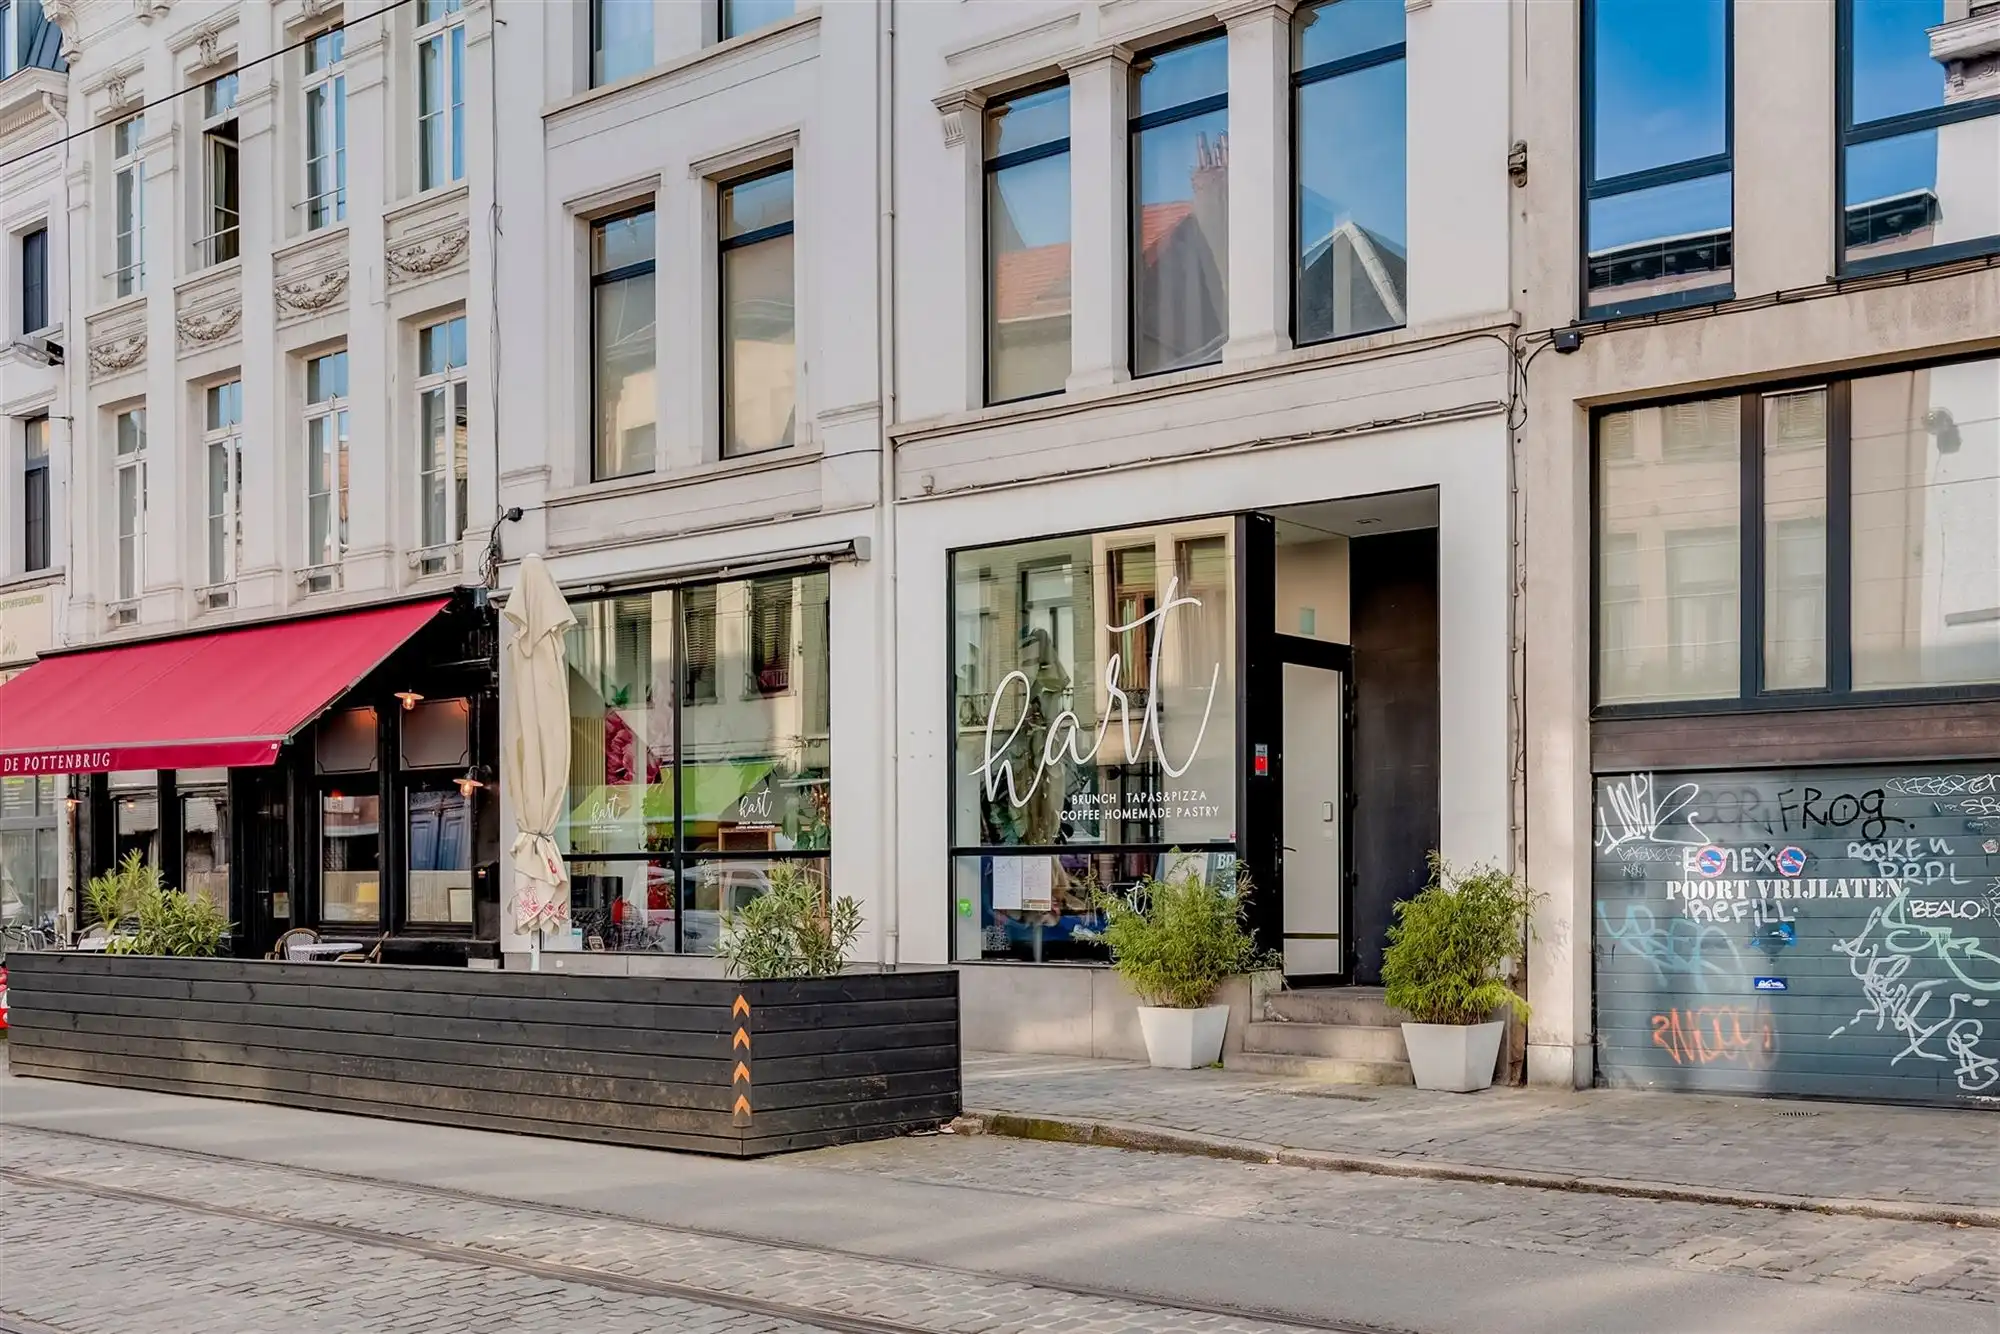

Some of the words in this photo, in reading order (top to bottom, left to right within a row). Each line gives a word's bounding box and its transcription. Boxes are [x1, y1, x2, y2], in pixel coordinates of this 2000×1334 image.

[968, 576, 1219, 807] hart
[4, 758, 19, 772] DE
[24, 752, 110, 771] POTTENBRUG
[739, 787, 773, 818] hart
[1072, 793, 1116, 805] BRUNCH
[1126, 791, 1207, 804] TAPAS&PIZZA
[1060, 809, 1100, 821] COFFEE
[1104, 807, 1172, 820] HOMEMADE
[1176, 805, 1220, 818] PASTRY
[1666, 880, 1750, 900] POORT
[1756, 878, 1904, 899] VRIJLATEN
